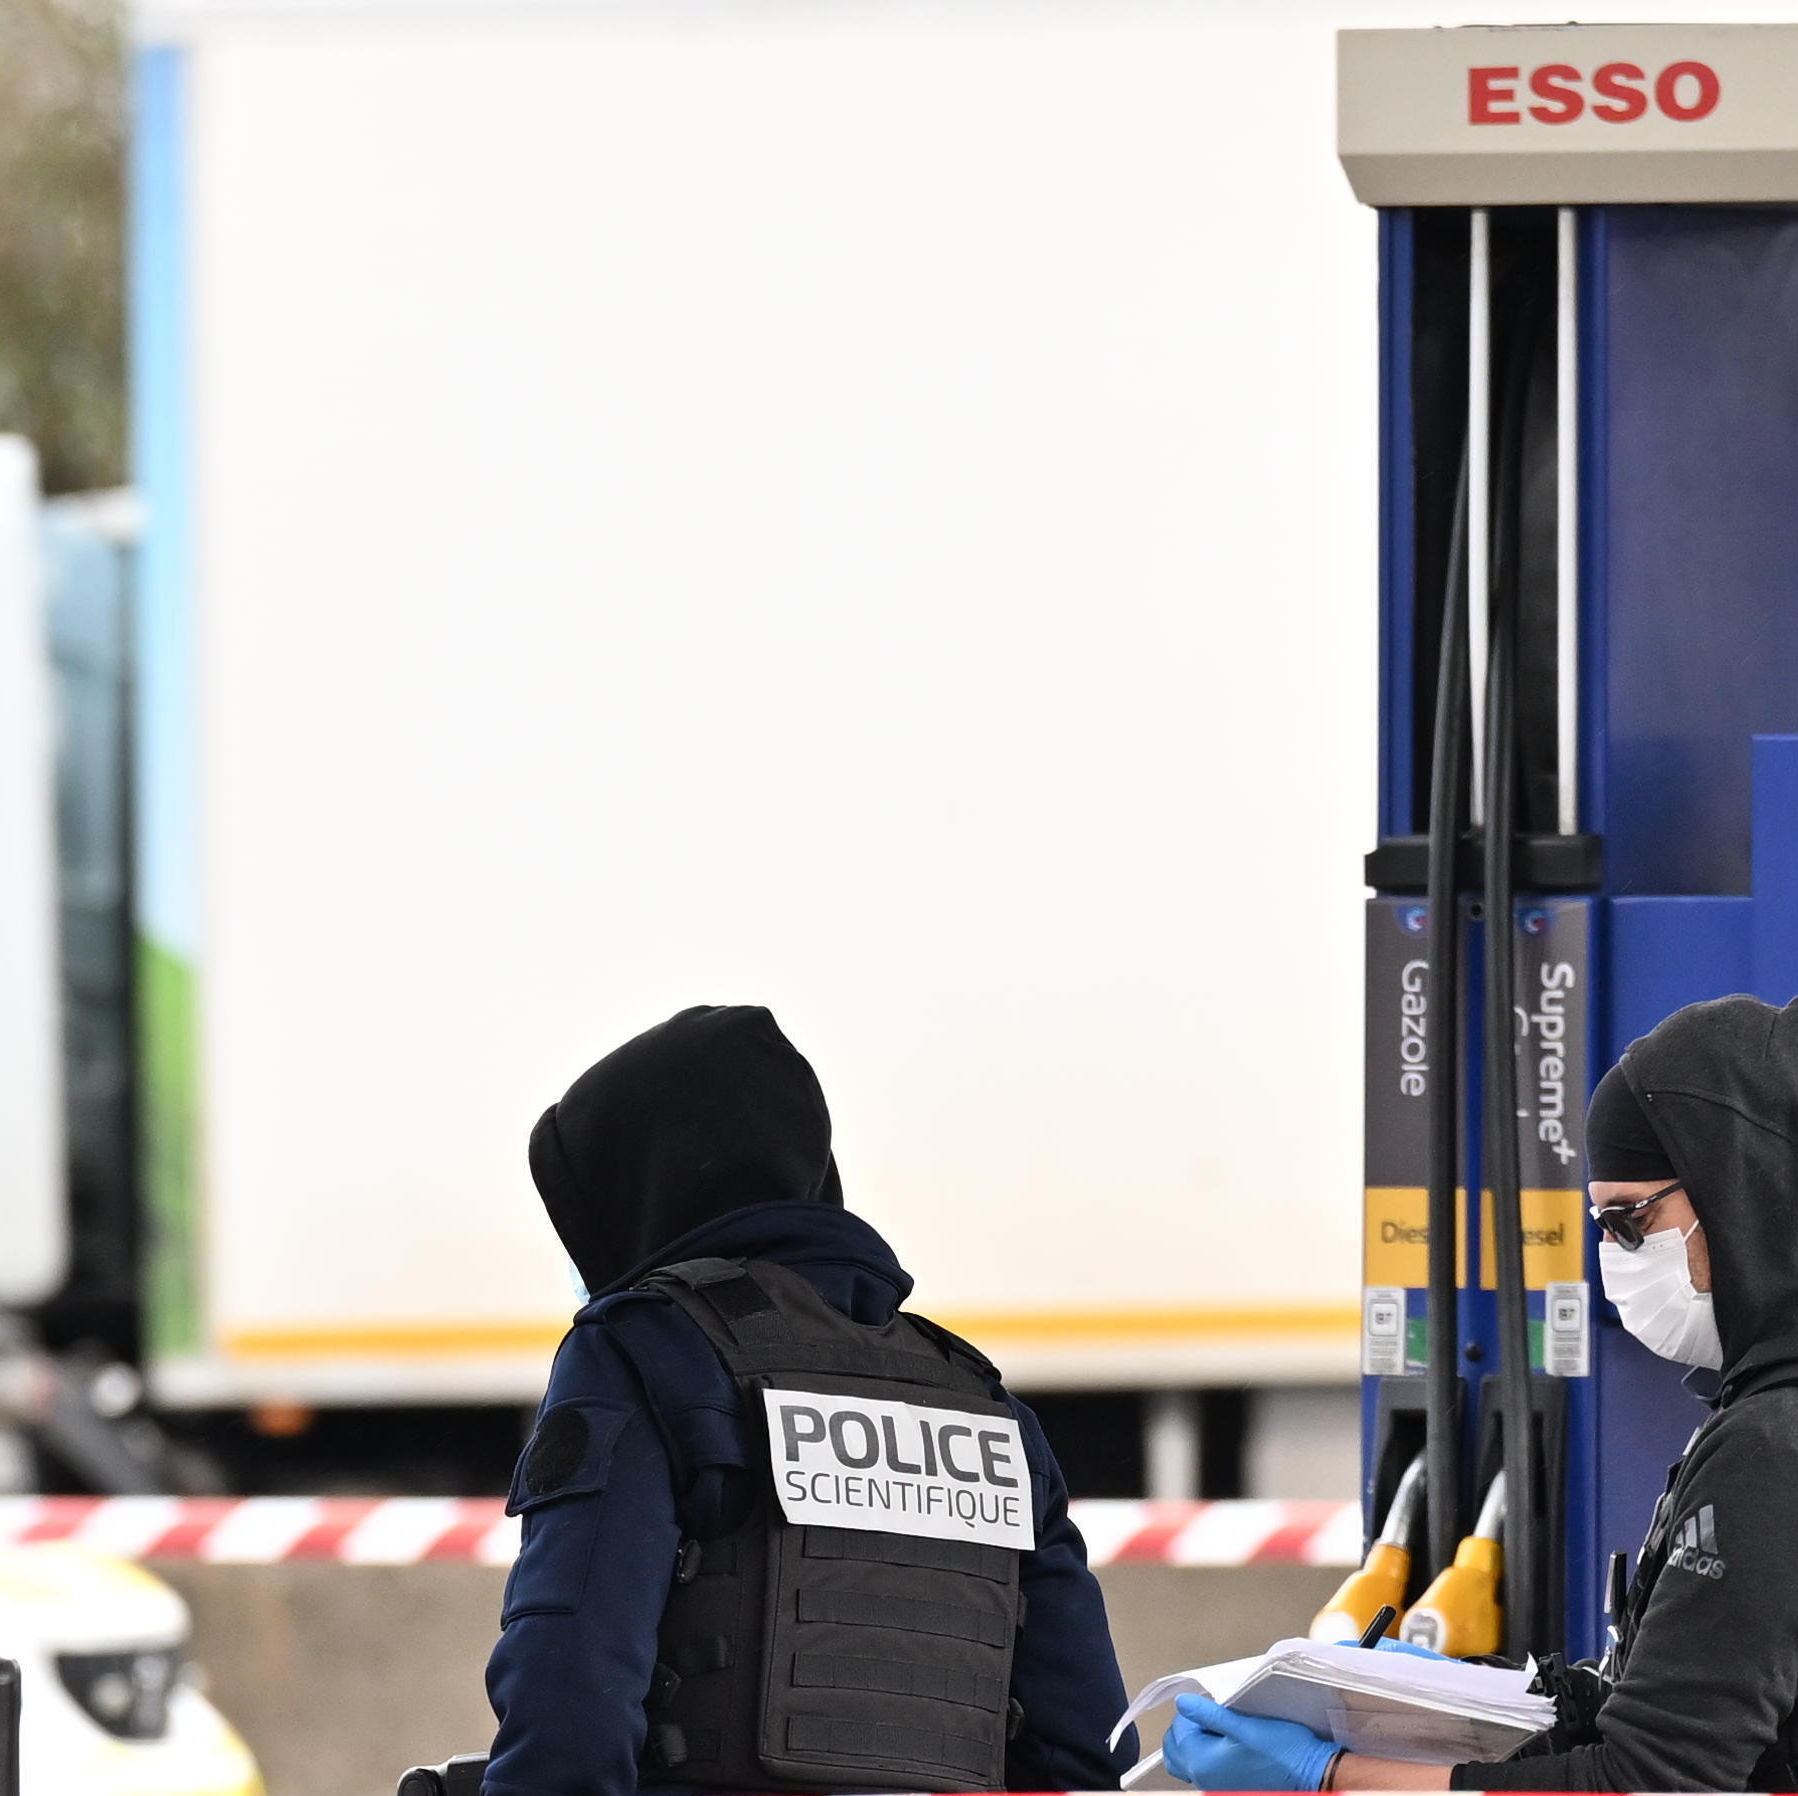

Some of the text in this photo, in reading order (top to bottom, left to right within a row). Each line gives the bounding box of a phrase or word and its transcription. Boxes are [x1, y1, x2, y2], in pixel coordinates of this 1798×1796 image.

[1467, 60, 1721, 126] ESSO
[1400, 958, 1431, 1097] Gazole
[779, 1404, 1019, 1489] POLICE
[785, 1469, 1021, 1529] SCIENTIFIQUE
